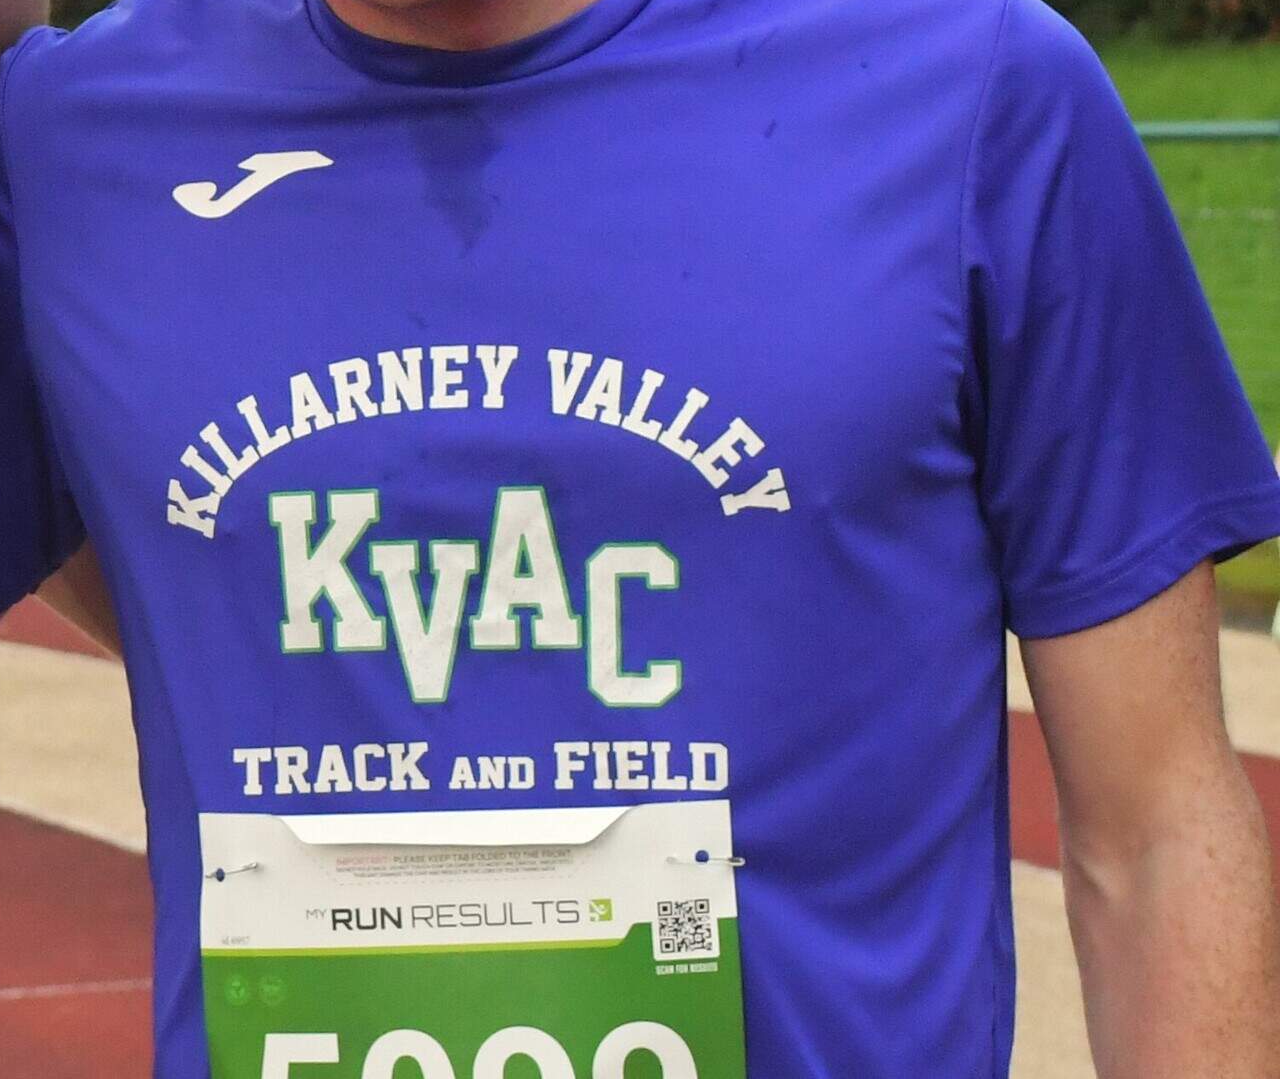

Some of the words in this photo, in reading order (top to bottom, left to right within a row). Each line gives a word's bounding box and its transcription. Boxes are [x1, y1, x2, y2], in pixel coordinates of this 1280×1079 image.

[166, 345, 518, 538] KILLARNEY
[547, 348, 791, 516] VALLEY
[269, 485, 681, 707] KVAC
[233, 742, 430, 795] TRACK
[449, 756, 535, 790] AND
[554, 741, 729, 792] FIELD
[306, 908, 327, 921] MY
[331, 907, 402, 931] RUN
[411, 900, 580, 928] RESULTS
